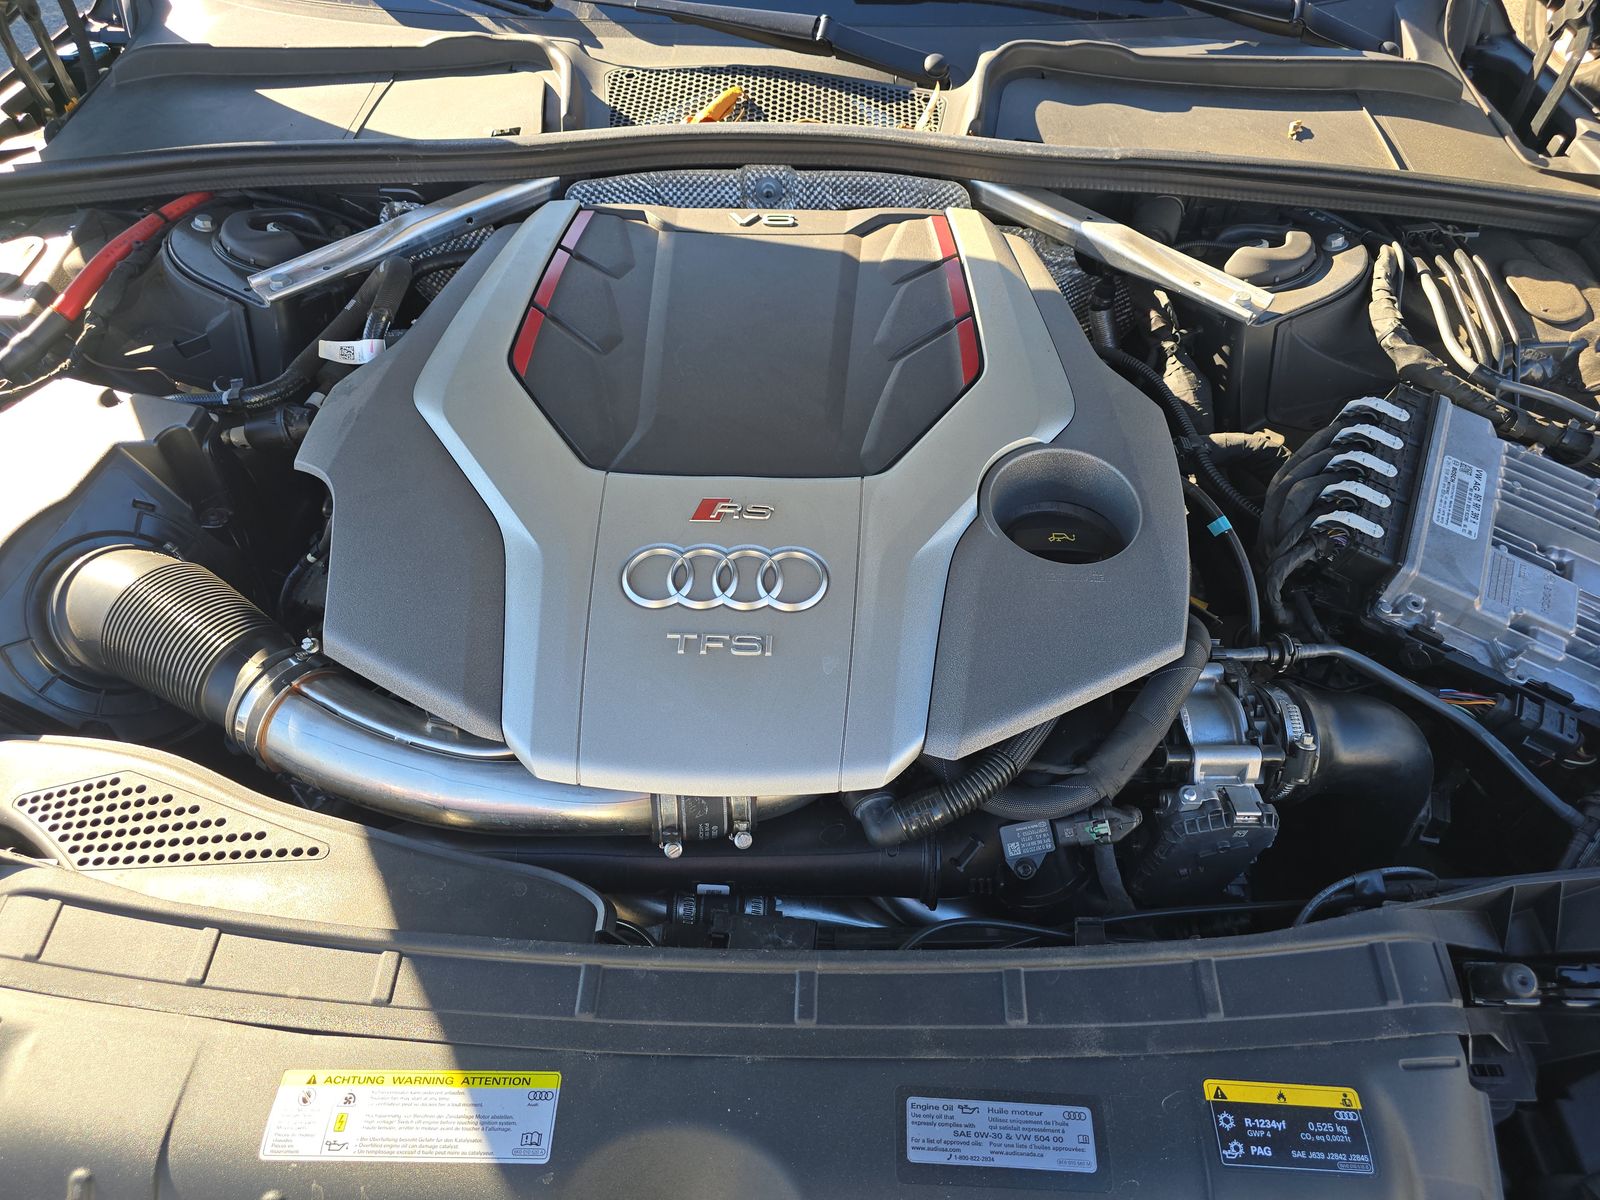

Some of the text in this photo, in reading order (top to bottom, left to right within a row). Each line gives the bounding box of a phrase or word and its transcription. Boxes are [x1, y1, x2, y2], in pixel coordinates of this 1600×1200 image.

[727, 212, 799, 228] V6
[709, 502, 776, 520] RS
[667, 633, 773, 657] TFSI
[324, 1076, 532, 1086] ACHTUNG WARNING ATTENTION
[910, 1102, 940, 1111] Engine
[988, 1106, 1044, 1117] Huile moteur
[1010, 1118, 1043, 1126] uniquement
[1244, 1118, 1286, 1132] R-1234yf
[1308, 1122, 1348, 1134] 0,525 kg
[974, 1131, 1003, 1140] 0W-30
[990, 1150, 1044, 1158] www.audicanada.ca
[1250, 1145, 1272, 1156] PAG
[1291, 1150, 1369, 1162] SAE J639 J2842 J2845
